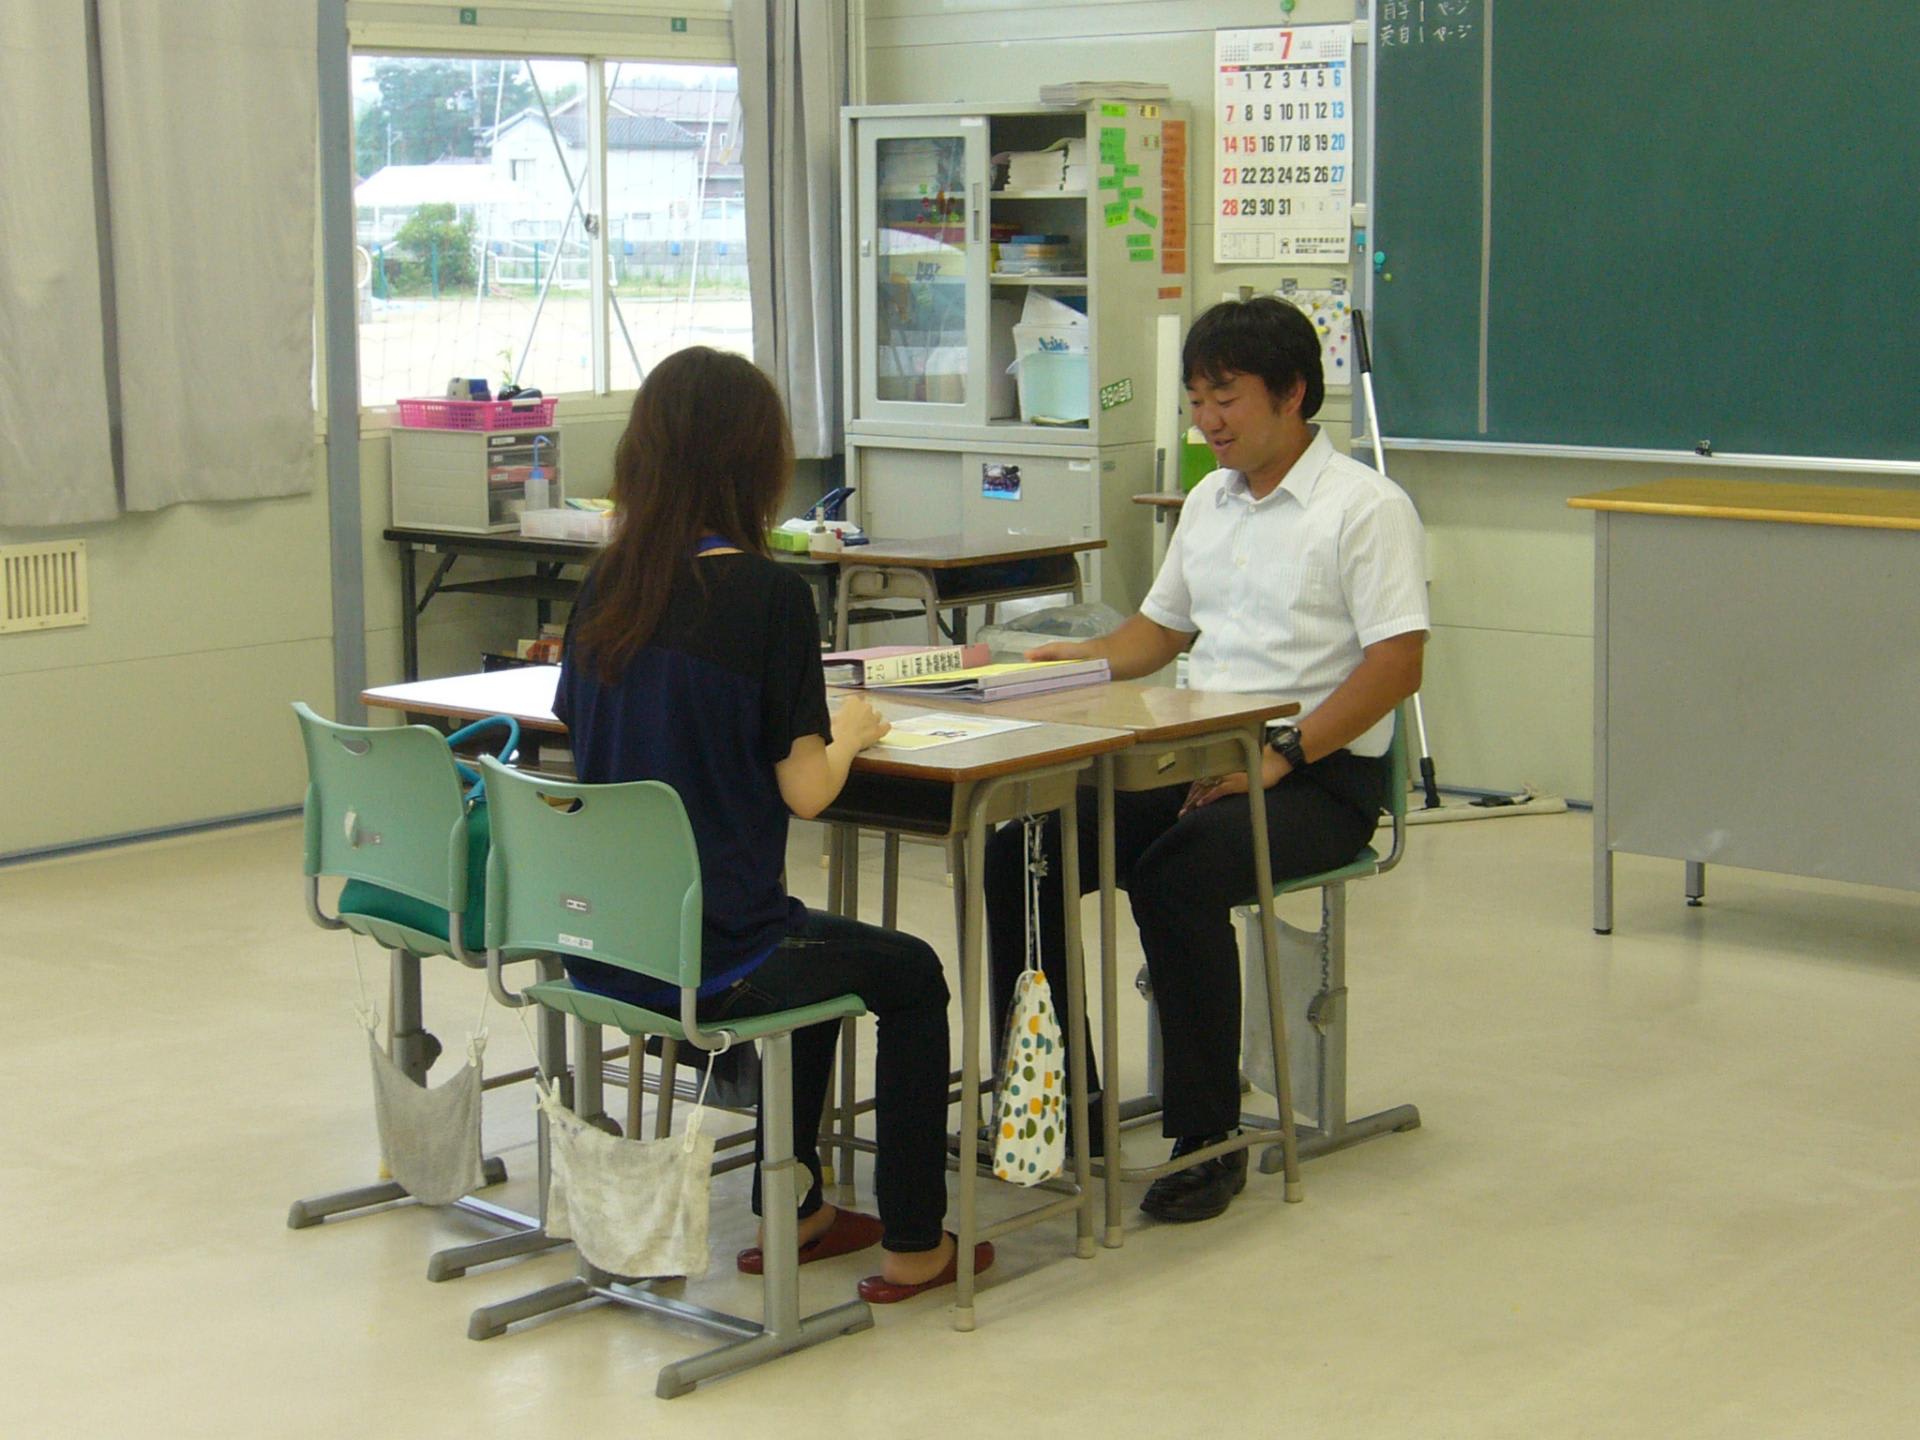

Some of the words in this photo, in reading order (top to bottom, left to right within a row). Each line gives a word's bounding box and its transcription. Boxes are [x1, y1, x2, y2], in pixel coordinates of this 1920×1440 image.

[1280, 32, 1293, 59] 7
[1245, 73, 1252, 89] 1
[1264, 72, 1272, 89] 2
[1283, 72, 1291, 88] 3
[1300, 71, 1308, 87] 4
[1317, 70, 1325, 87] 5
[1333, 69, 1341, 87] 6
[1226, 105, 1234, 122] 7
[1245, 104, 1253, 121] 8
[1263, 104, 1272, 120] 9
[1280, 103, 1293, 120] 10
[1298, 103, 1309, 119] 11
[1314, 102, 1328, 119] 12
[1331, 101, 1345, 118] 13
[1223, 136, 1237, 152] 14
[1243, 136, 1256, 152] 15
[1261, 136, 1275, 152] 16
[1279, 135, 1293, 152] 17
[1298, 134, 1311, 151] 18
[1314, 134, 1328, 151] 19
[1331, 133, 1345, 150] 20
[1223, 168, 1237, 184] 21
[1241, 167, 1256, 184] 22
[1260, 167, 1275, 184] 23
[1278, 167, 1292, 183] 24
[1296, 166, 1311, 183] 25
[1314, 166, 1328, 183] 26
[1331, 165, 1345, 182] 27
[1222, 199, 1238, 216] 28
[1241, 199, 1256, 215] 29
[1260, 199, 1274, 215] 30
[1278, 198, 1291, 215] 31
